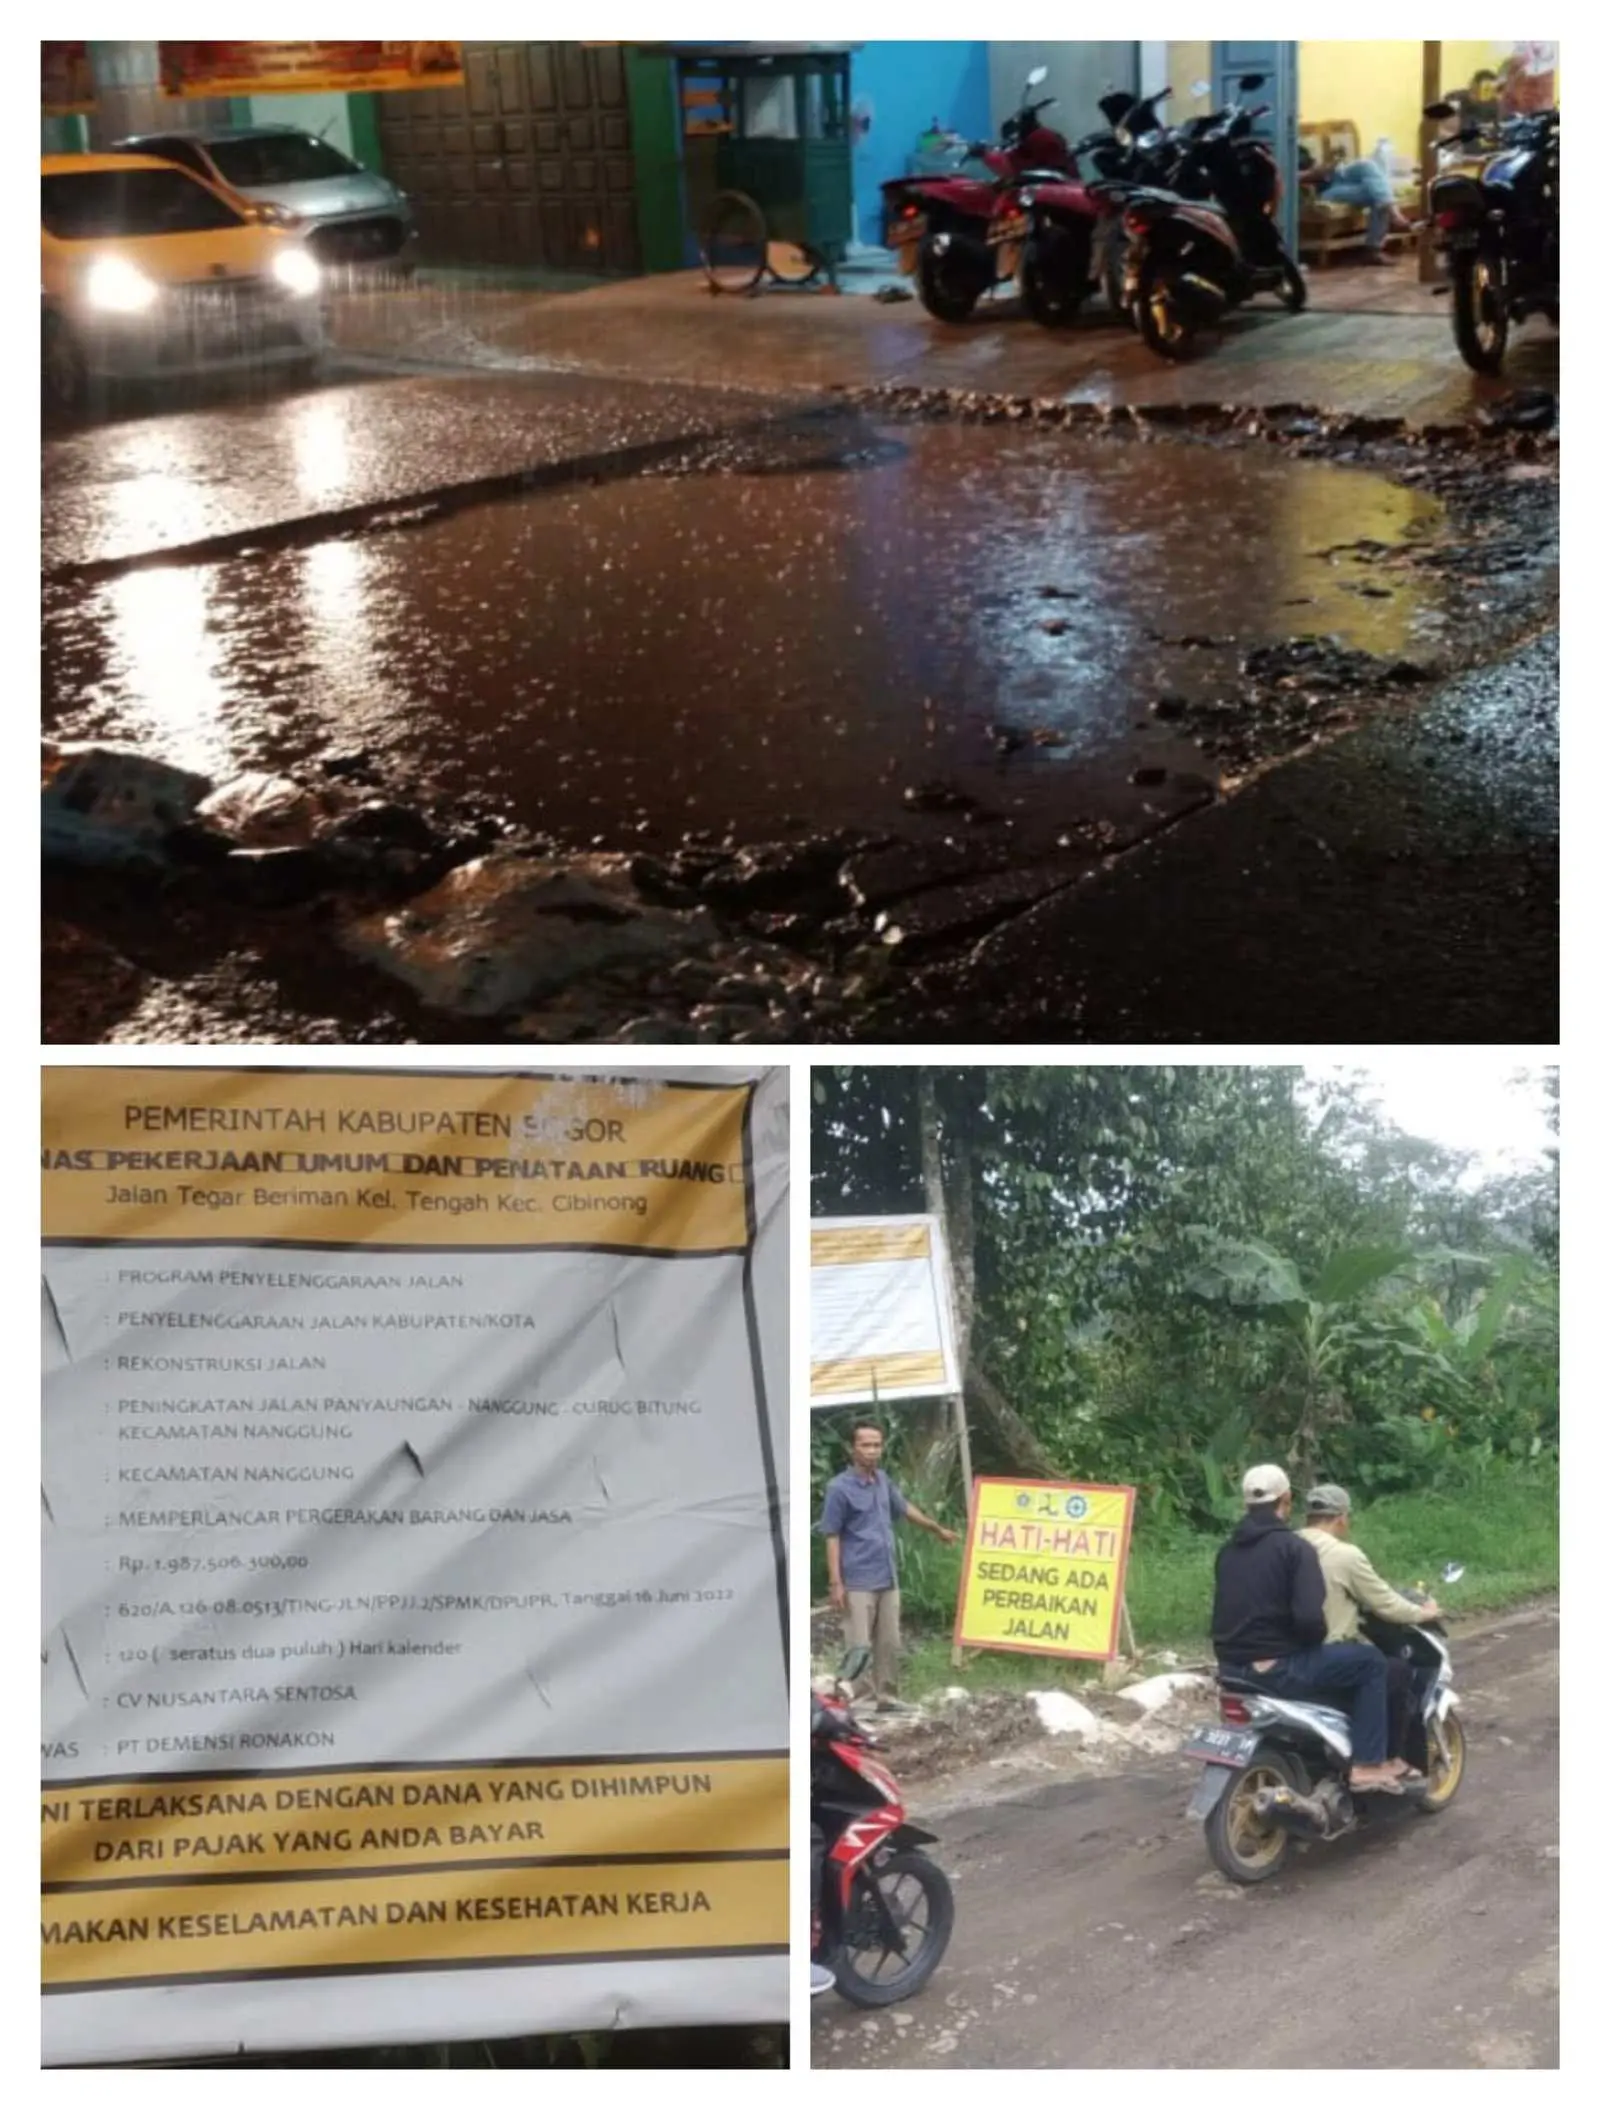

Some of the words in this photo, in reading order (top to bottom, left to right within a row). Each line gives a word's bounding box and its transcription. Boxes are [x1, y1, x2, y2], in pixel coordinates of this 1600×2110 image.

[124, 1106, 326, 1132] PEMERINTAH
[338, 1109, 512, 1138] KABUPATEN
[107, 1150, 283, 1173] PEKERJAAN
[299, 1152, 389, 1173] UMUM
[403, 1154, 462, 1176] DAN
[475, 1157, 627, 1181] PENATAAN
[640, 1159, 725, 1184] RUANG
[106, 1185, 168, 1205] Jalan
[177, 1185, 245, 1211] Tegar
[253, 1187, 350, 1208] Beriman
[356, 1188, 397, 1210] Kel.
[406, 1190, 489, 1215] Tengah
[497, 1193, 543, 1213] Kec.
[551, 1193, 648, 1216] Cibinong
[118, 1269, 214, 1285] PROGRAM
[219, 1270, 402, 1289] PENYELENGGARAAN
[407, 1274, 464, 1290] JALAN
[118, 1311, 305, 1330] PENYELENGGARAAN
[310, 1314, 367, 1330] JALAN
[372, 1314, 536, 1330] KABUPATEN/KOTA
[117, 1355, 263, 1372] REKONSTRUKSI
[266, 1356, 326, 1371] JALAN
[118, 1399, 253, 1416] PENINGKATAN
[258, 1399, 318, 1414] JALAN
[324, 1398, 453, 1414] PANYAUNGAN
[467, 1400, 559, 1417] NANGGUNG
[636, 1400, 703, 1417] BITUNG
[118, 1424, 238, 1441] KECAMATAN
[243, 1424, 353, 1440] NANGGUNG
[118, 1466, 238, 1483] KECAMATAN
[243, 1465, 355, 1482] NANGGUNG
[118, 1510, 280, 1528] MEMPERLANCAR
[285, 1508, 404, 1526] PERGERAKAN
[408, 1508, 487, 1525] BARANG
[488, 1508, 528, 1524] DAN
[528, 1508, 573, 1525] JASA
[979, 1521, 1117, 1559] HATI-HATI
[976, 1561, 1060, 1587] SEDANG
[1064, 1570, 1109, 1591] ADA
[561, 1588, 632, 1607] Tanggal
[982, 1588, 1098, 1617] PERBAIKAN
[1002, 1617, 1070, 1641] JALAN
[168, 1647, 237, 1662] seratus
[241, 1644, 276, 1660] dua
[280, 1640, 333, 1662] puluh
[350, 1638, 384, 1656] Hari
[386, 1638, 463, 1657] kalender
[116, 1693, 142, 1709] CV
[147, 1687, 270, 1708] NUSANTARA
[273, 1685, 358, 1702] SENTOSA
[117, 1739, 140, 1755] PT
[146, 1735, 236, 1754] DEMENSI
[239, 1732, 335, 1749] RONAKON
[79, 1792, 268, 1822] TERLAKSANA
[275, 1784, 394, 1811] DENGAN
[403, 1782, 483, 1807] DANA
[488, 1779, 565, 1803] YANG
[571, 1774, 713, 1800] DIHIMPUN
[93, 1838, 164, 1863] DARI
[173, 1833, 266, 1858] PAJAK
[273, 1829, 352, 1852] YANG
[360, 1826, 442, 1850] ANDA
[449, 1821, 545, 1846] BAYAR
[157, 1904, 379, 1940] KESELAMATAN
[386, 1901, 447, 1924] DAN
[455, 1894, 619, 1922] KESEHATAN
[626, 1890, 712, 1915] KERJA
